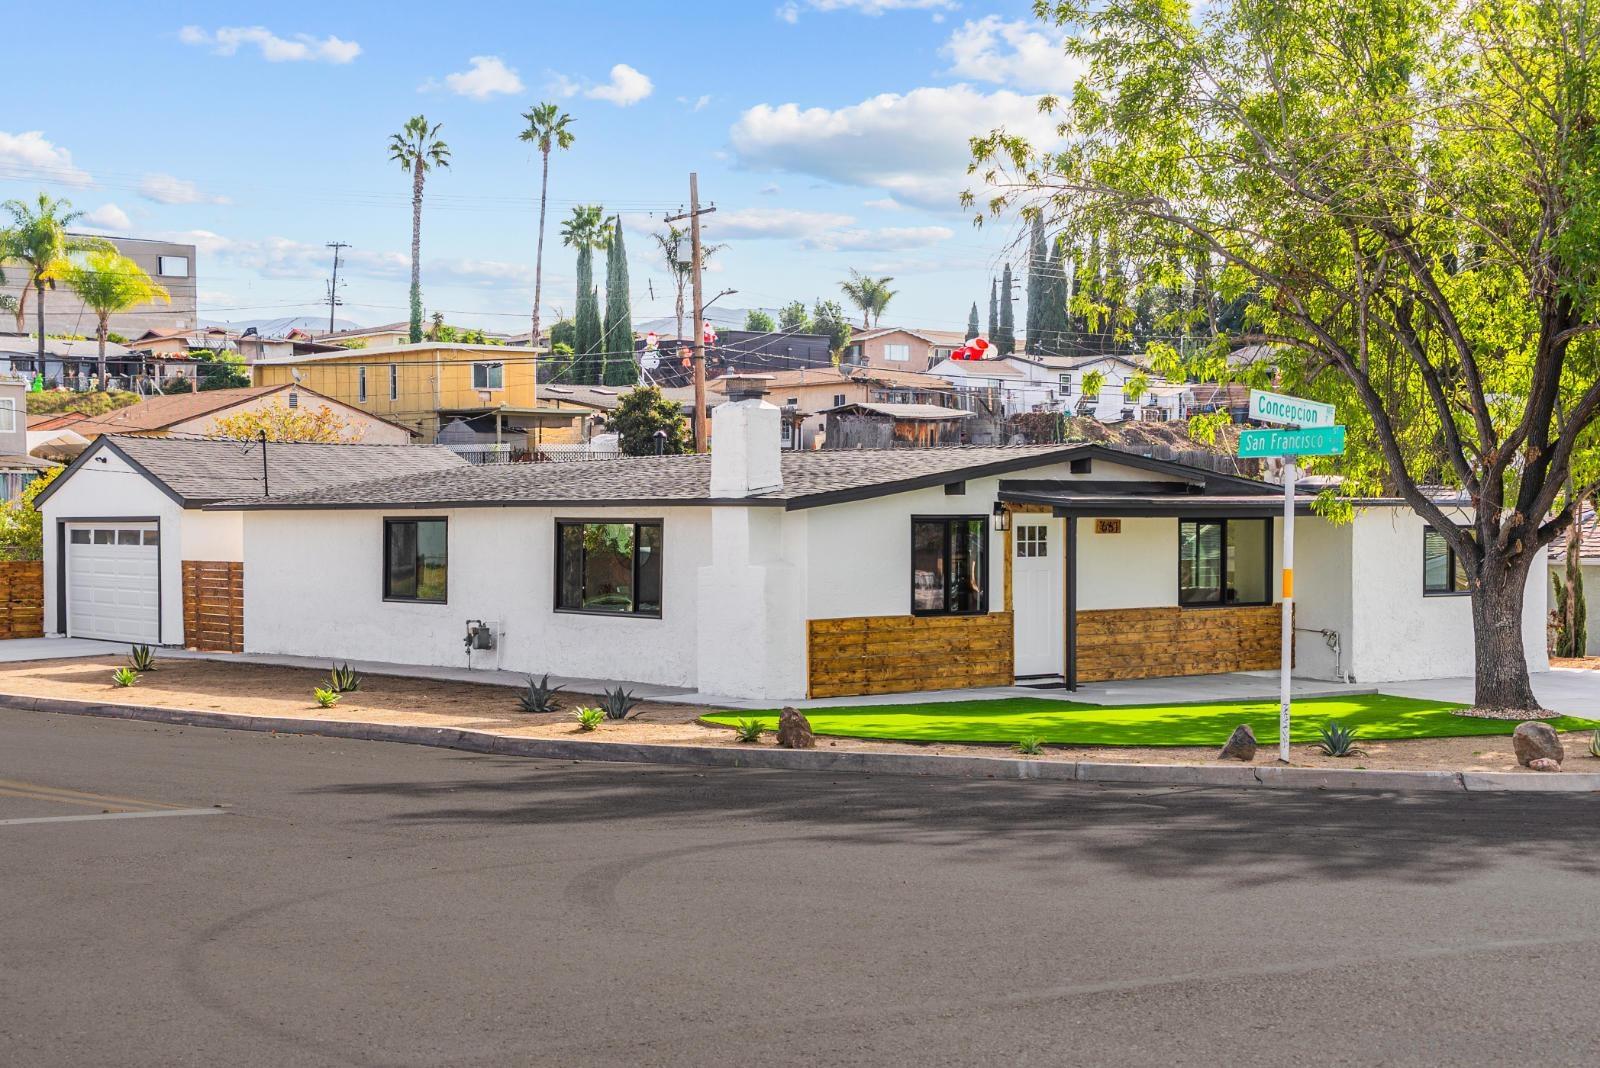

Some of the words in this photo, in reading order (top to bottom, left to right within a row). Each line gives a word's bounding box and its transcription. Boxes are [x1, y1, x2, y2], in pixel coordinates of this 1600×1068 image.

[1258, 395, 1318, 423] Concepcion
[1246, 434, 1265, 451] San
[1271, 433, 1323, 450] Francisco
